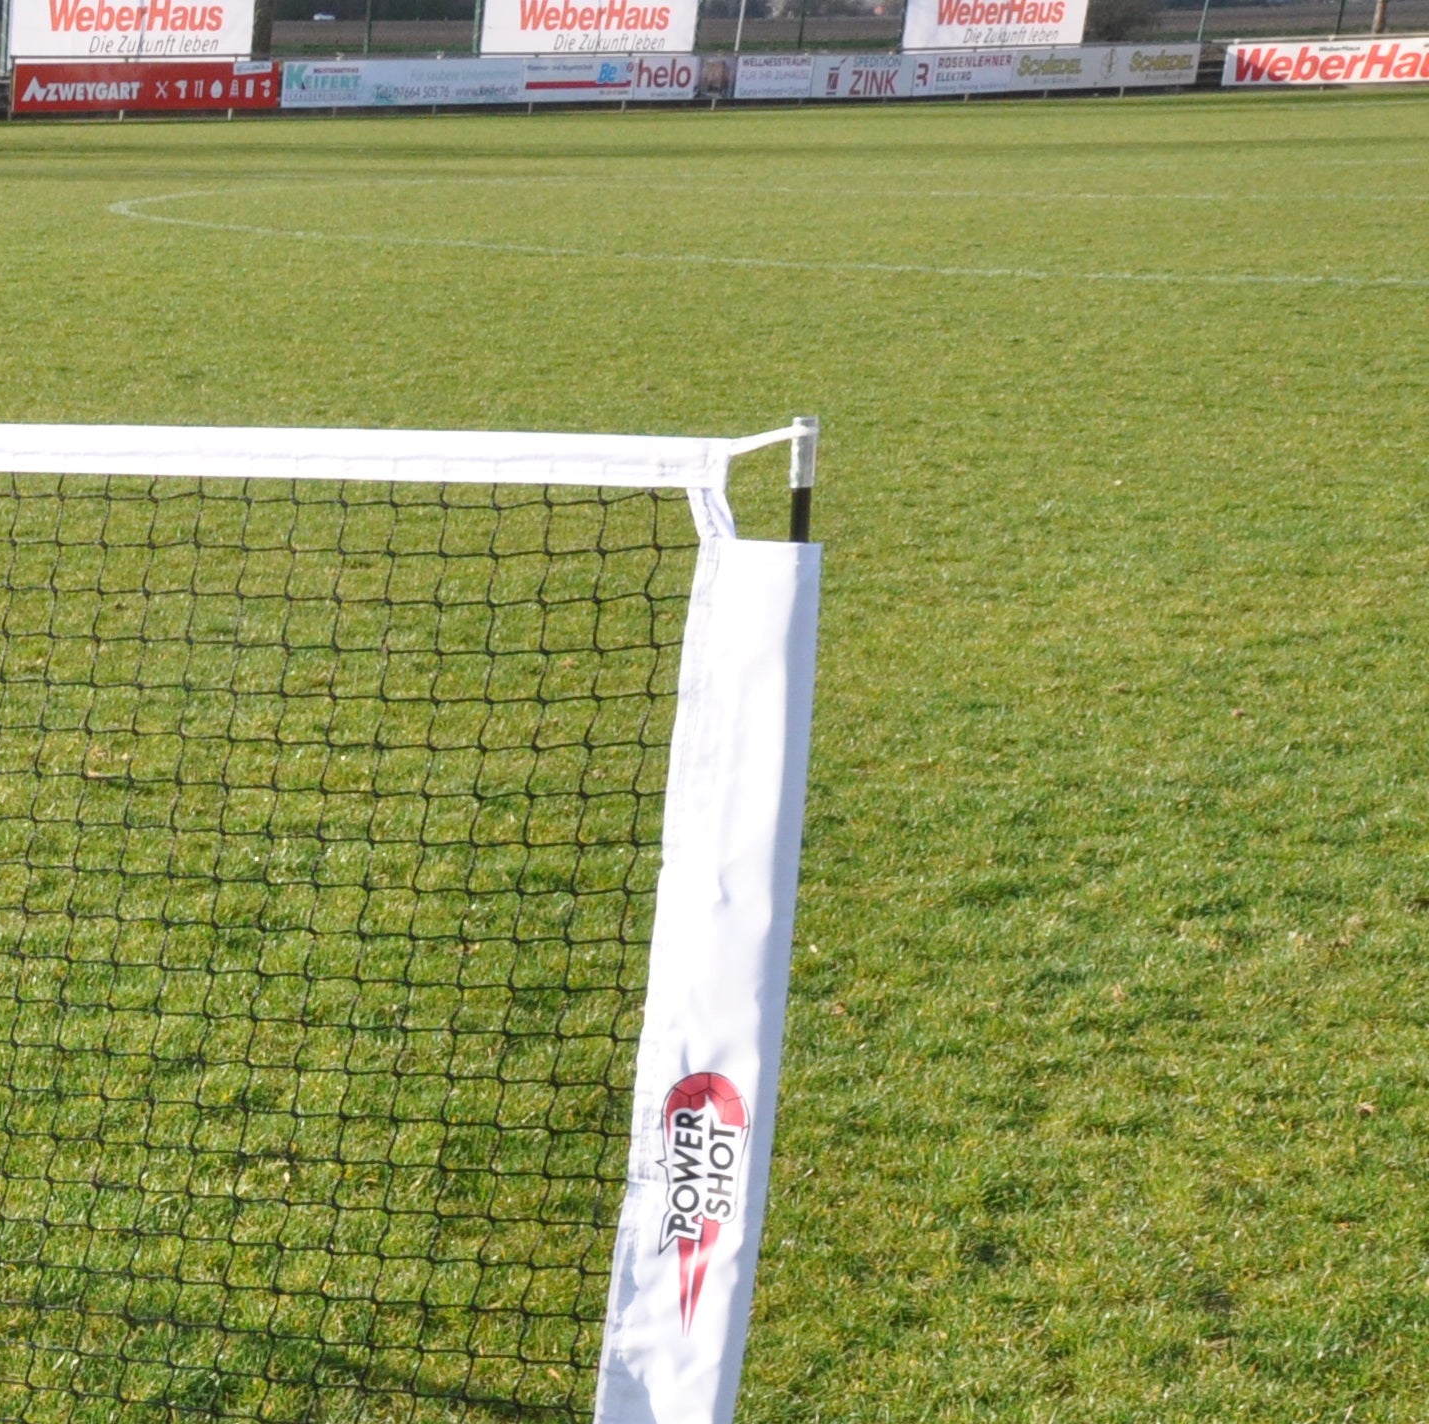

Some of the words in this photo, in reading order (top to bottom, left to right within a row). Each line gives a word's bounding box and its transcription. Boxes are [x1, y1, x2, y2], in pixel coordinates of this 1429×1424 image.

[48, 0, 224, 32] WeberHaus
[519, 0, 671, 31] WeberHaus
[937, 0, 1065, 26] WeberHaus
[89, 35, 114, 54] Die
[117, 34, 176, 56] Zukunft
[179, 34, 220, 53] leben
[553, 34, 576, 51] Die
[578, 33, 629, 52] Zukunft
[631, 33, 666, 50] leben
[963, 28, 980, 44] Die
[983, 28, 1027, 46] Zukunft
[1028, 27, 1059, 43] leben
[636, 57, 691, 89] helo
[853, 56, 902, 68] SPEDITION
[938, 54, 1013, 69] ROSENLEHNER
[284, 63, 363, 91] KEIFERT
[849, 69, 899, 96] ZINK
[43, 81, 140, 102] ZWEYGART
[666, 1111, 704, 1235] POWER
[705, 1119, 736, 1218] SHOT
